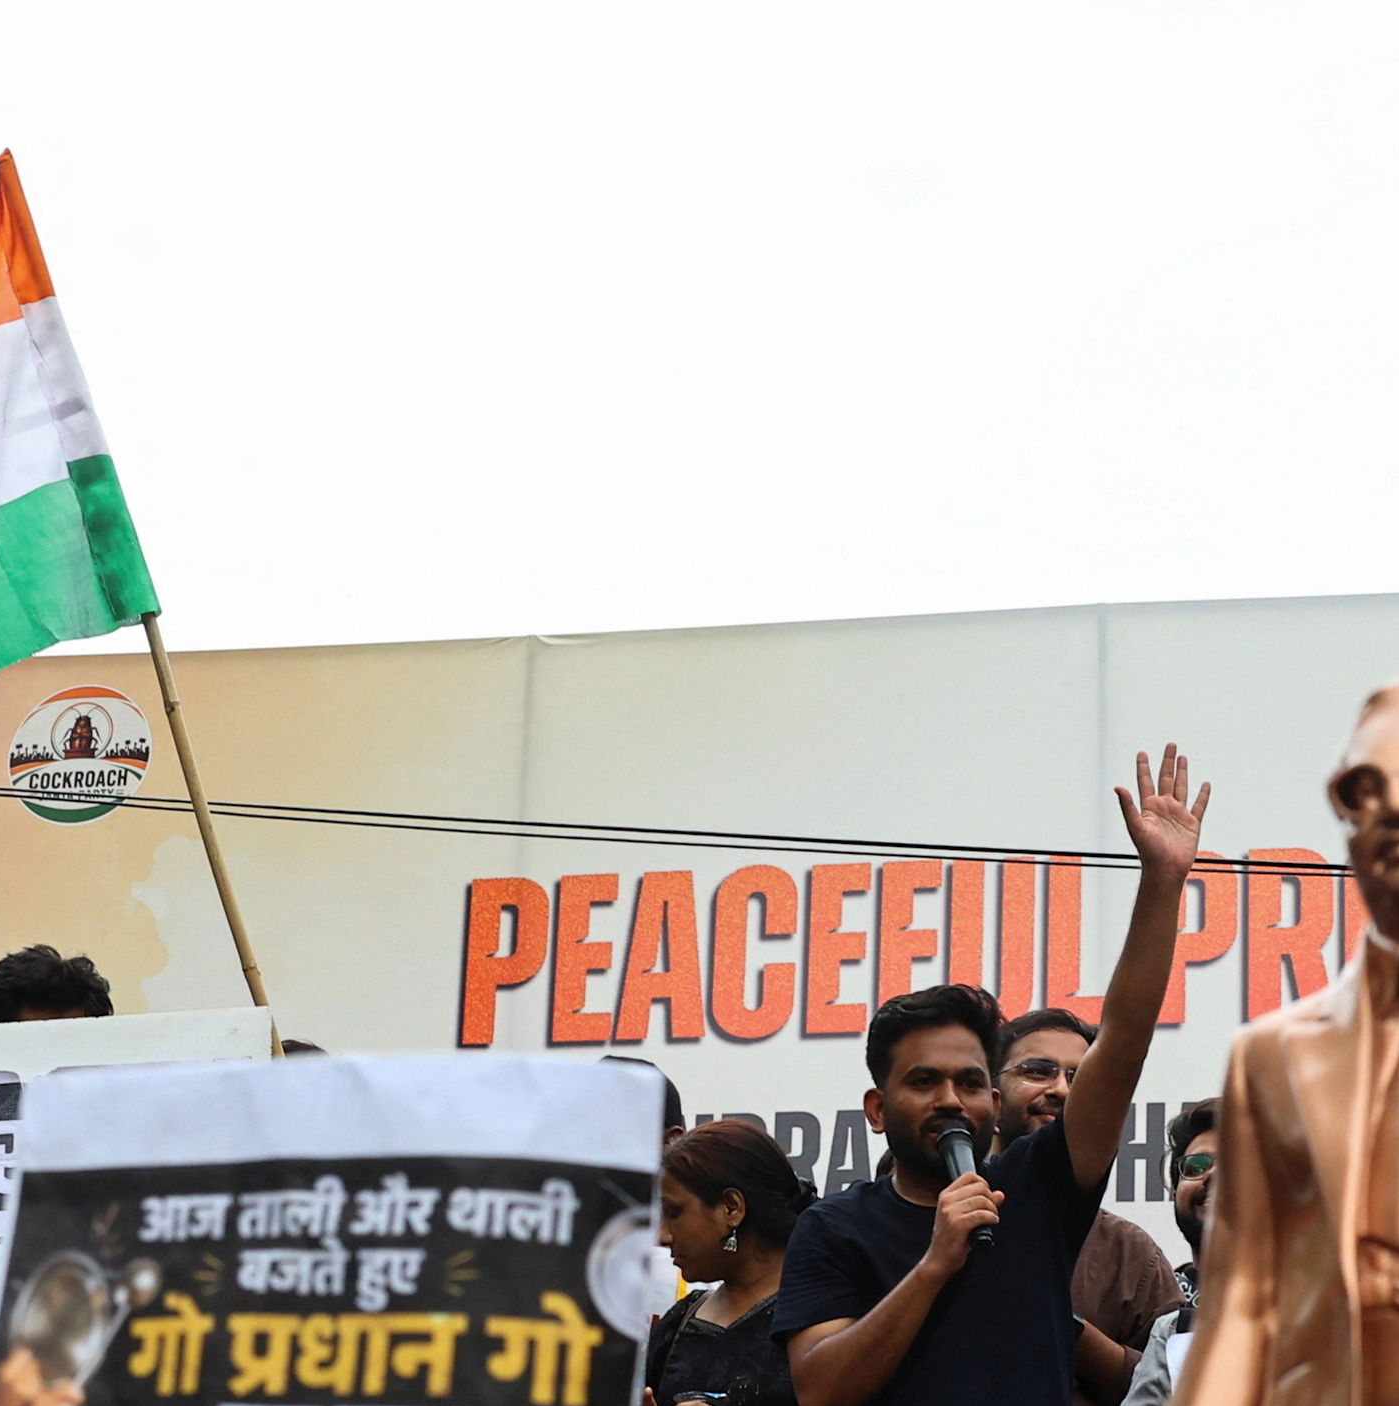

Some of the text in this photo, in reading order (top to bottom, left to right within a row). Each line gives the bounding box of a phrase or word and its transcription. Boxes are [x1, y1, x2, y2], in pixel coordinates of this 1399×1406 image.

[29, 769, 128, 790] COCKROACH
[460, 855, 1104, 1047] PEACEFUL
[139, 1170, 581, 1247] आज ताली और थाली
[236, 1238, 427, 1312] बजते हुए
[127, 1291, 216, 1397] गो
[227, 1312, 470, 1398] प्रधान
